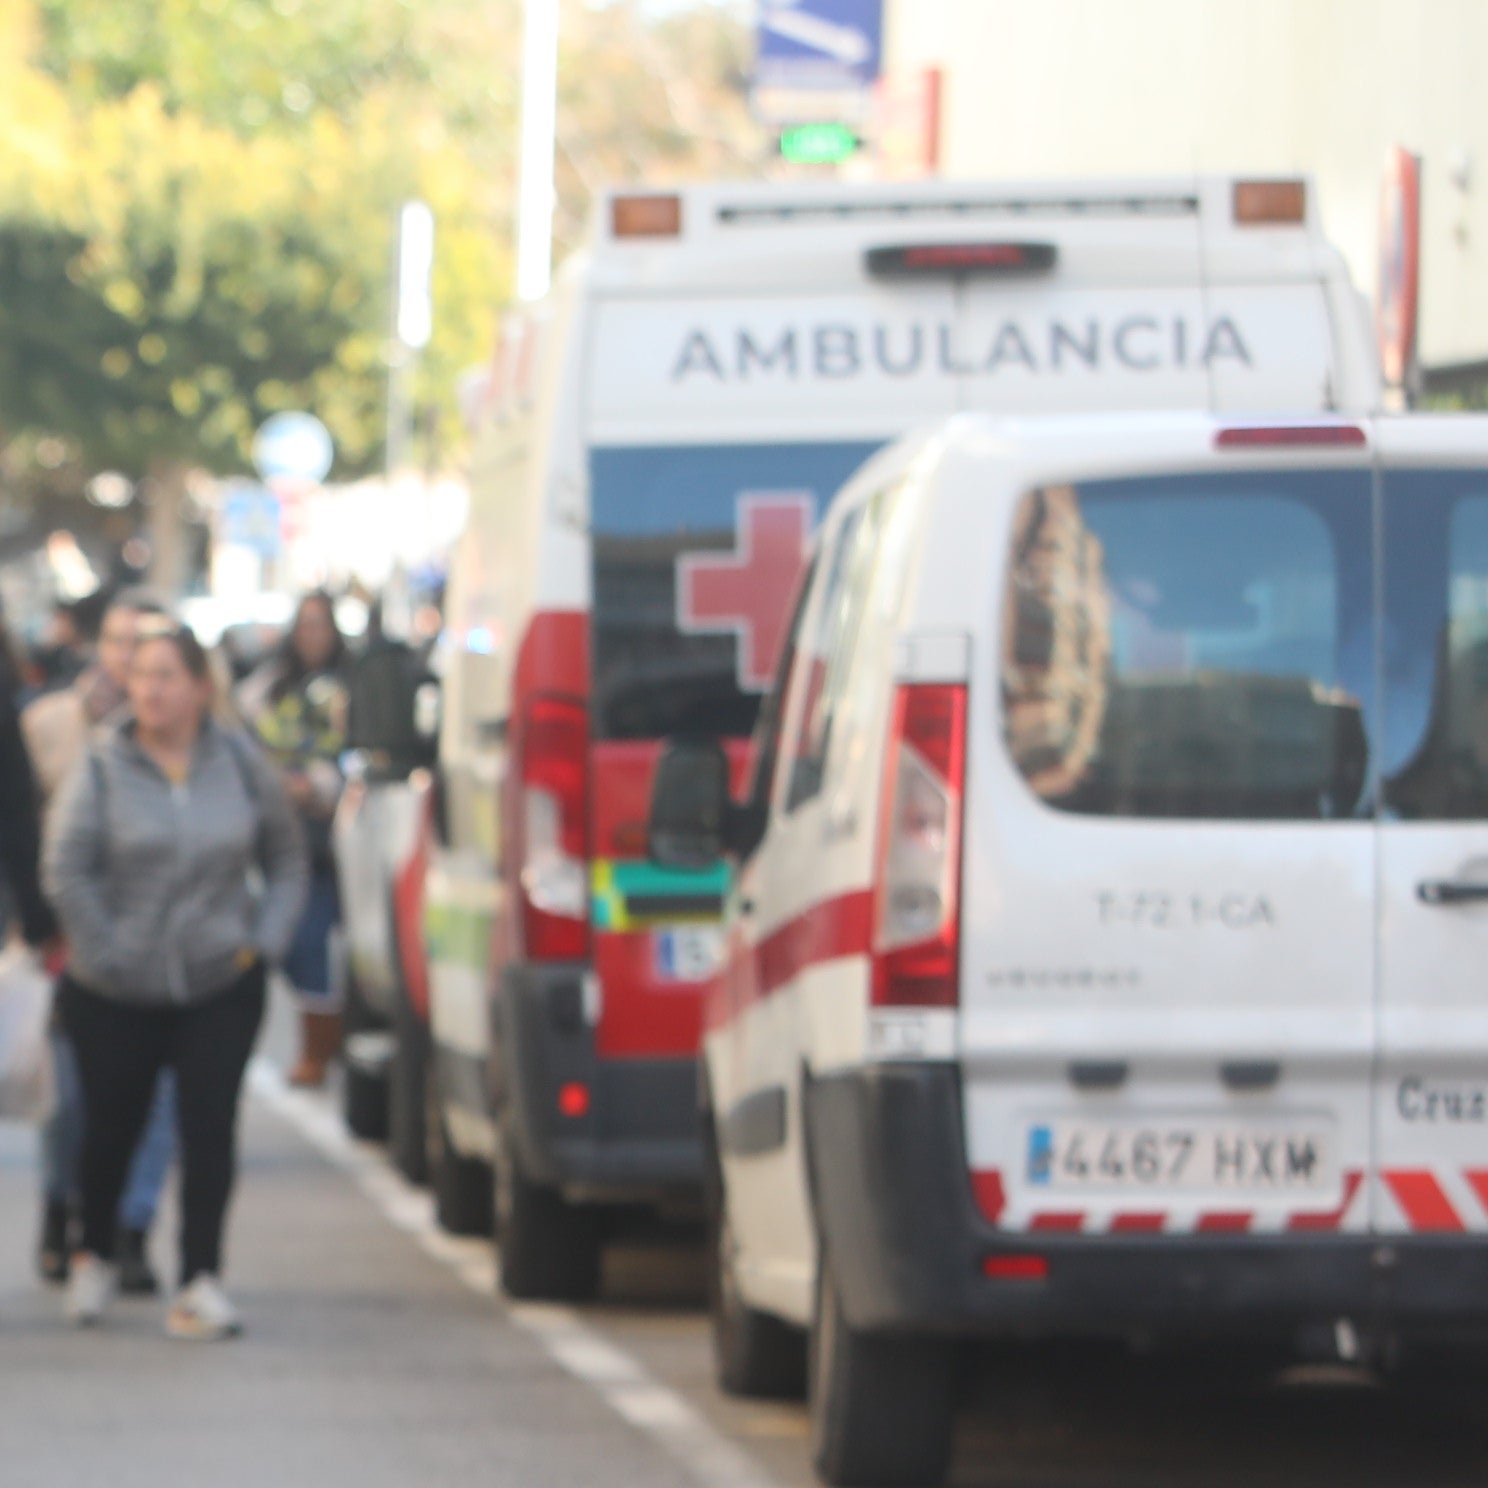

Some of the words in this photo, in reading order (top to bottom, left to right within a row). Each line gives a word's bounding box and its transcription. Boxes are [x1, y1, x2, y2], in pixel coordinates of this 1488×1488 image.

[671, 314, 1255, 384] AMBULANCIA
[1063, 1128, 1196, 1182] 4467
[1212, 1131, 1320, 1184] HXM
